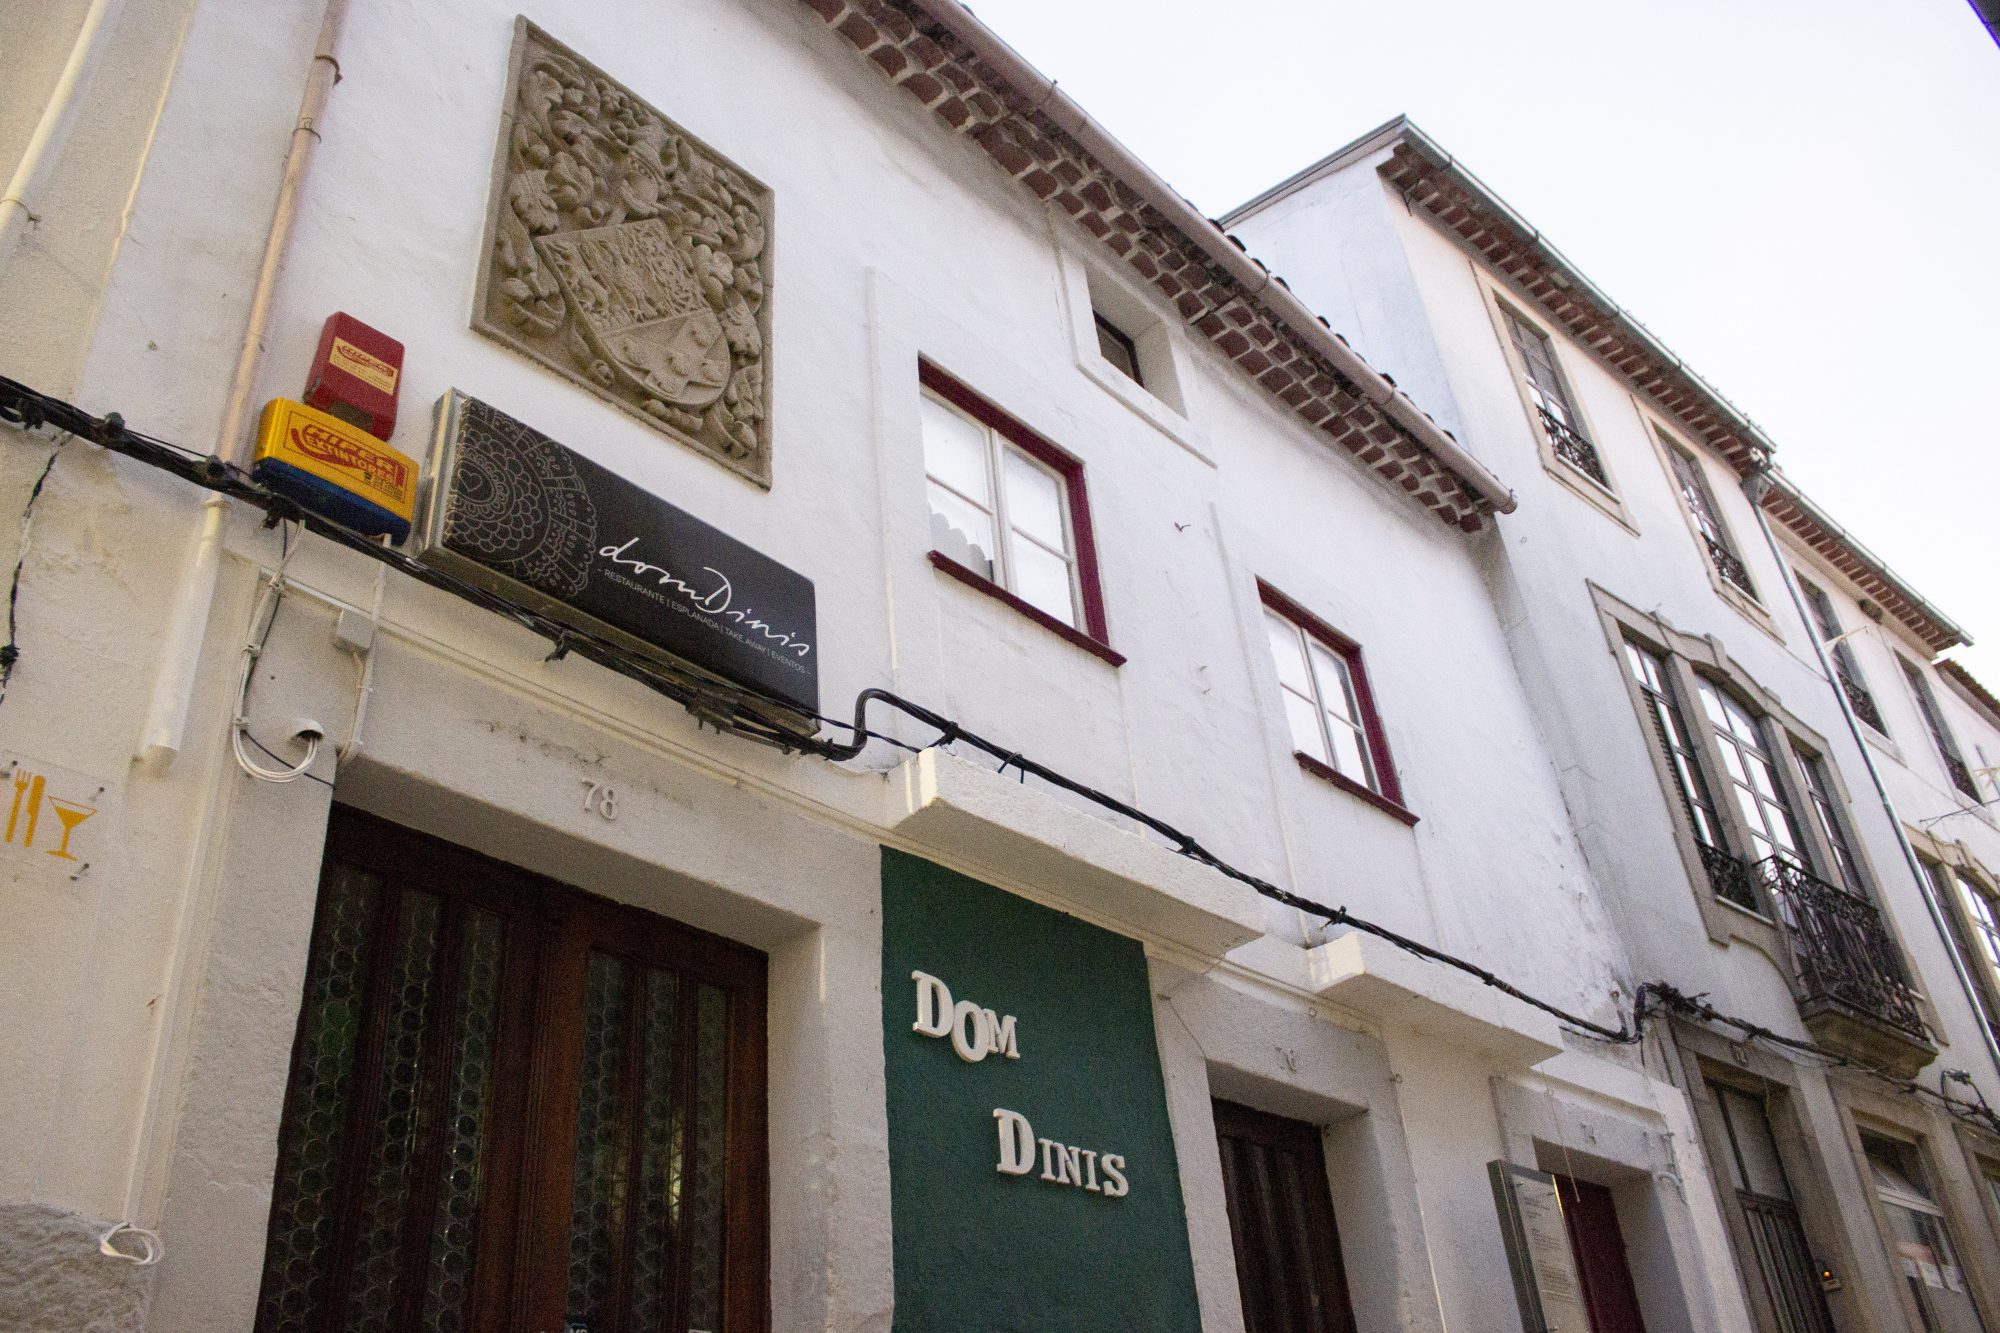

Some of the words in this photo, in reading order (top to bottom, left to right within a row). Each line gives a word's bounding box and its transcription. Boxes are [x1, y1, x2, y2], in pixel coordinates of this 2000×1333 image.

[604, 569, 665, 604] RESTAURANTE
[671, 601, 720, 631] ESPLANADA
[725, 627, 744, 642] TAKE
[745, 638, 767, 652] AWAY
[771, 650, 806, 674] EVENTOS
[581, 777, 619, 821] 78
[911, 969, 1021, 1063] DOM
[992, 1108, 1130, 1198] DINIS
